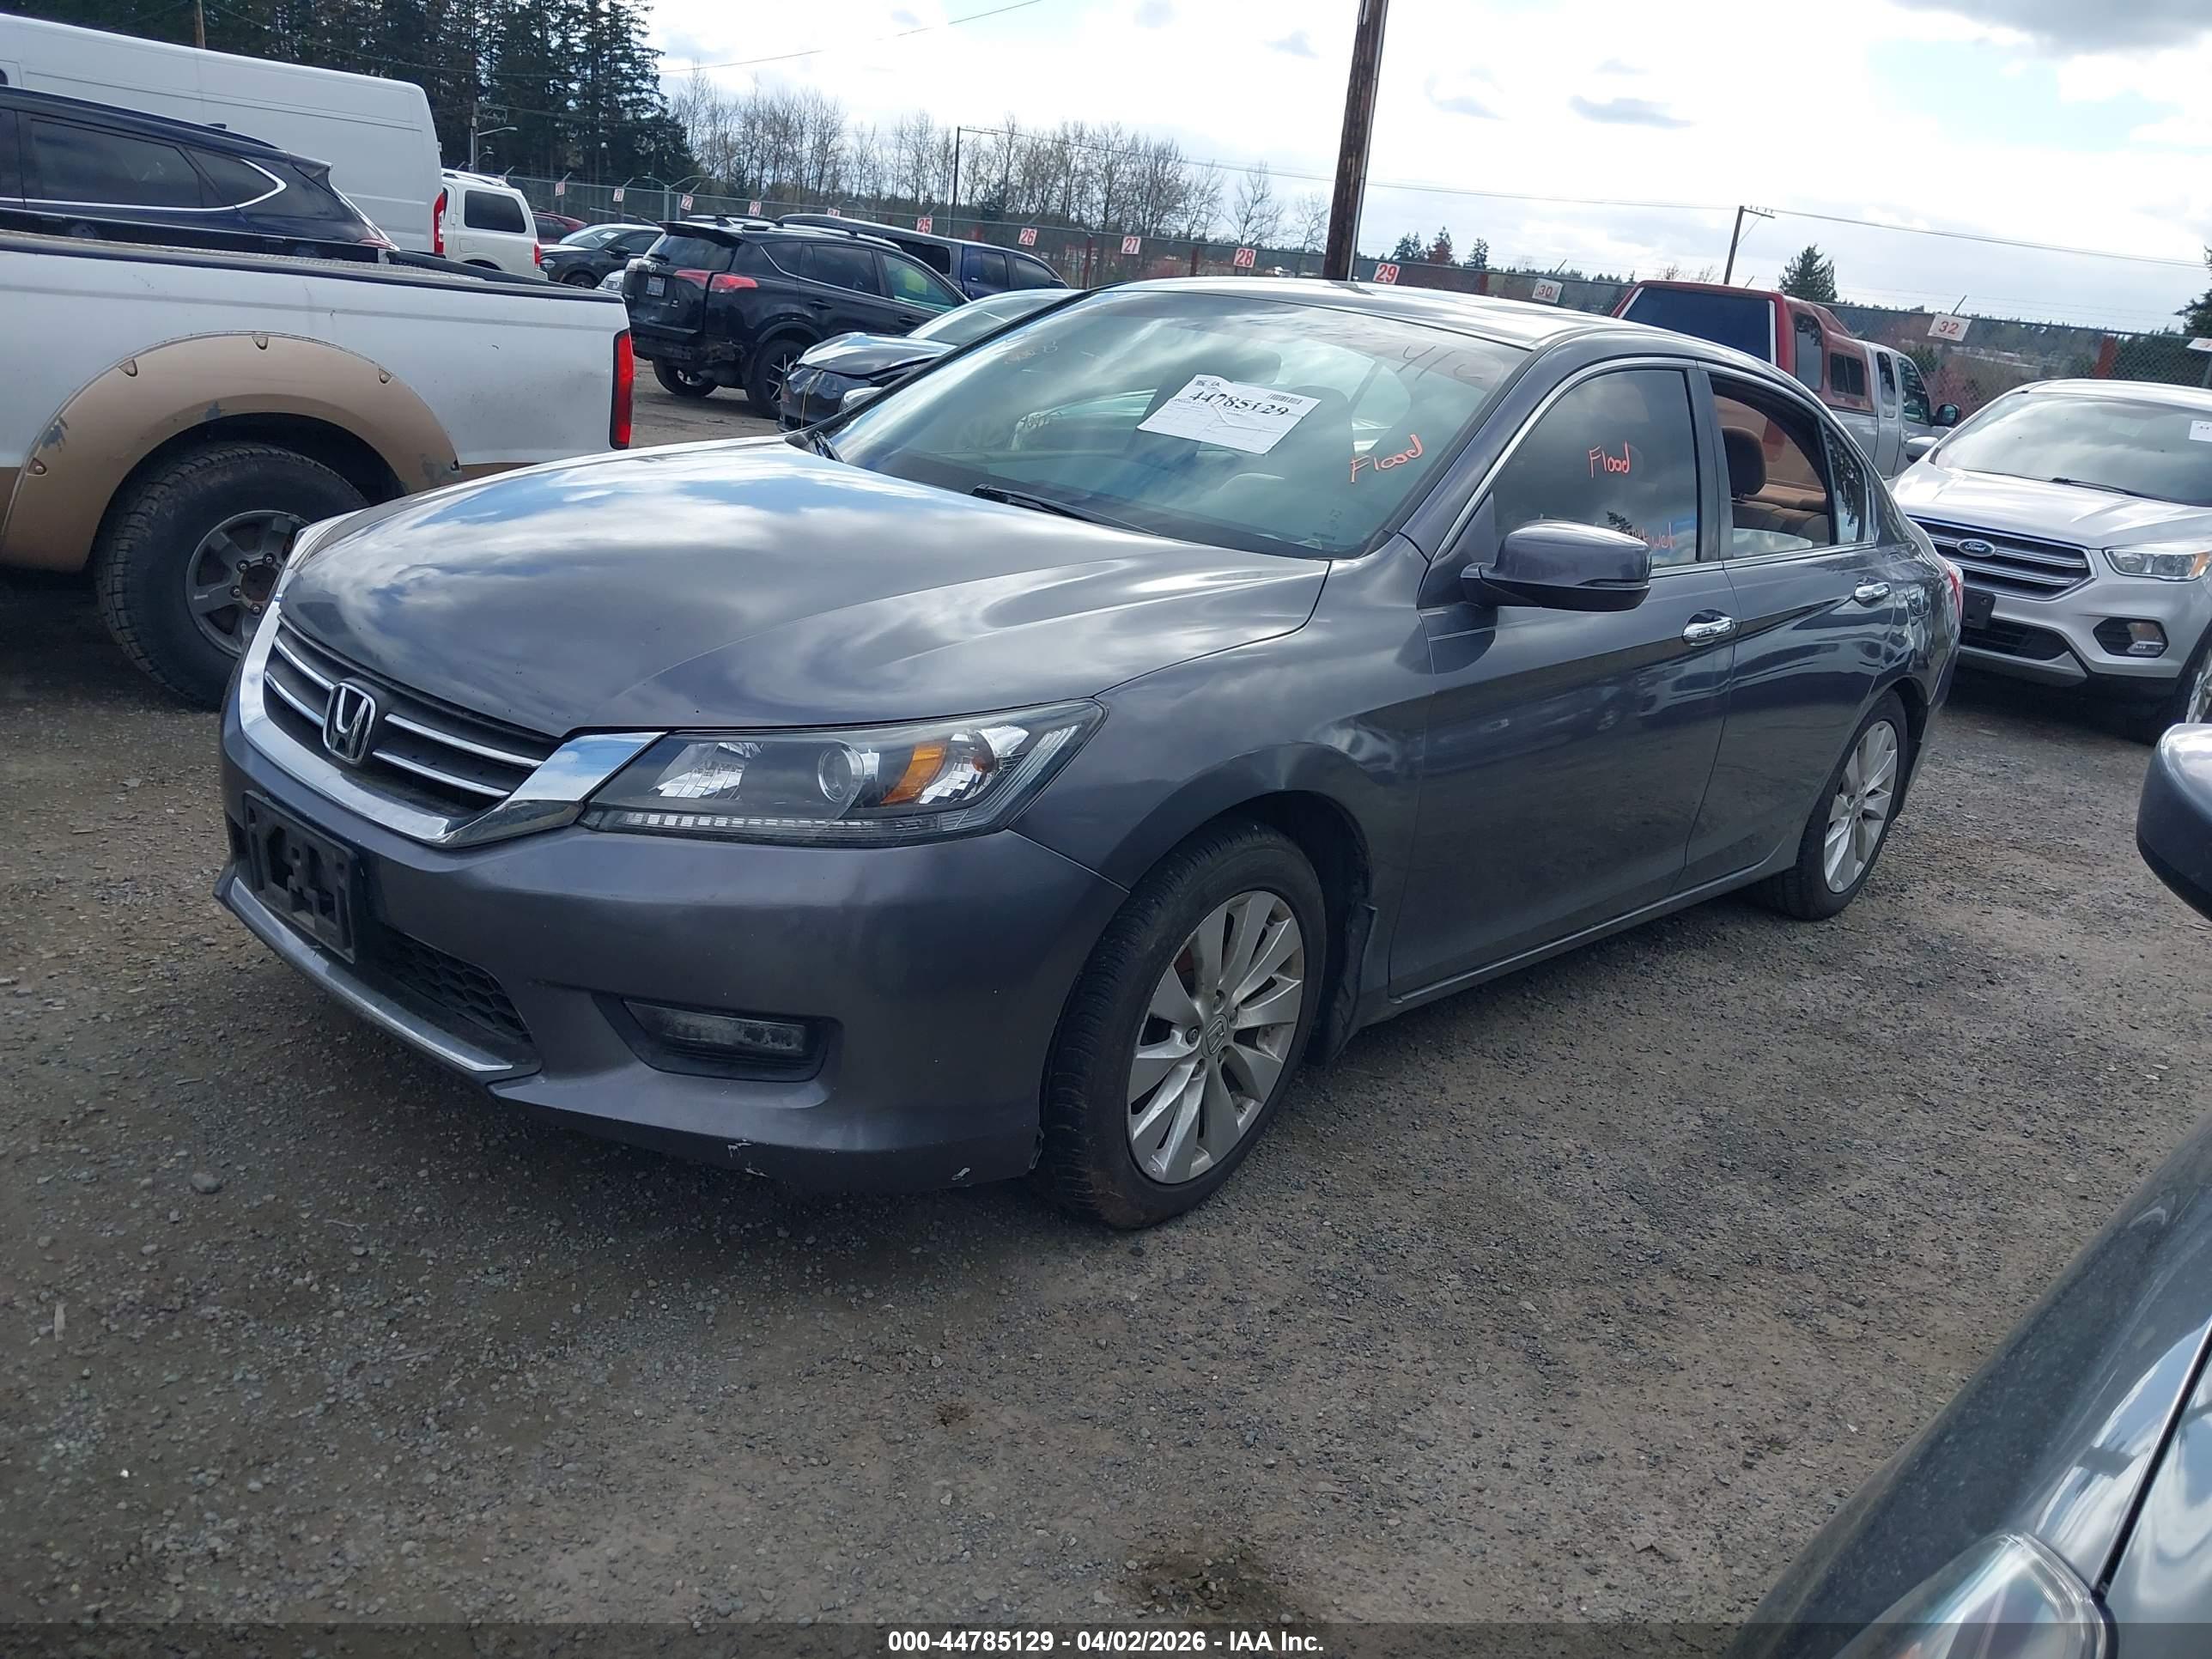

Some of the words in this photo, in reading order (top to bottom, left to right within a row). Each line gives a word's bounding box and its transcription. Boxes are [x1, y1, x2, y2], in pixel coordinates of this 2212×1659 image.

[683, 196, 694, 210] 22
[918, 218, 931, 232] 25
[1020, 229, 1036, 245] 26
[1123, 238, 1139, 253] 27
[1235, 249, 1253, 267] 28
[1376, 263, 1396, 283] 29
[1538, 284, 1553, 297] 30
[1939, 320, 1960, 334] 32
[1188, 391, 1290, 416] 44785129
[1350, 434, 1424, 483] Flood
[1589, 440, 1631, 478] Flood
[1964, 542, 1986, 552] Ford
